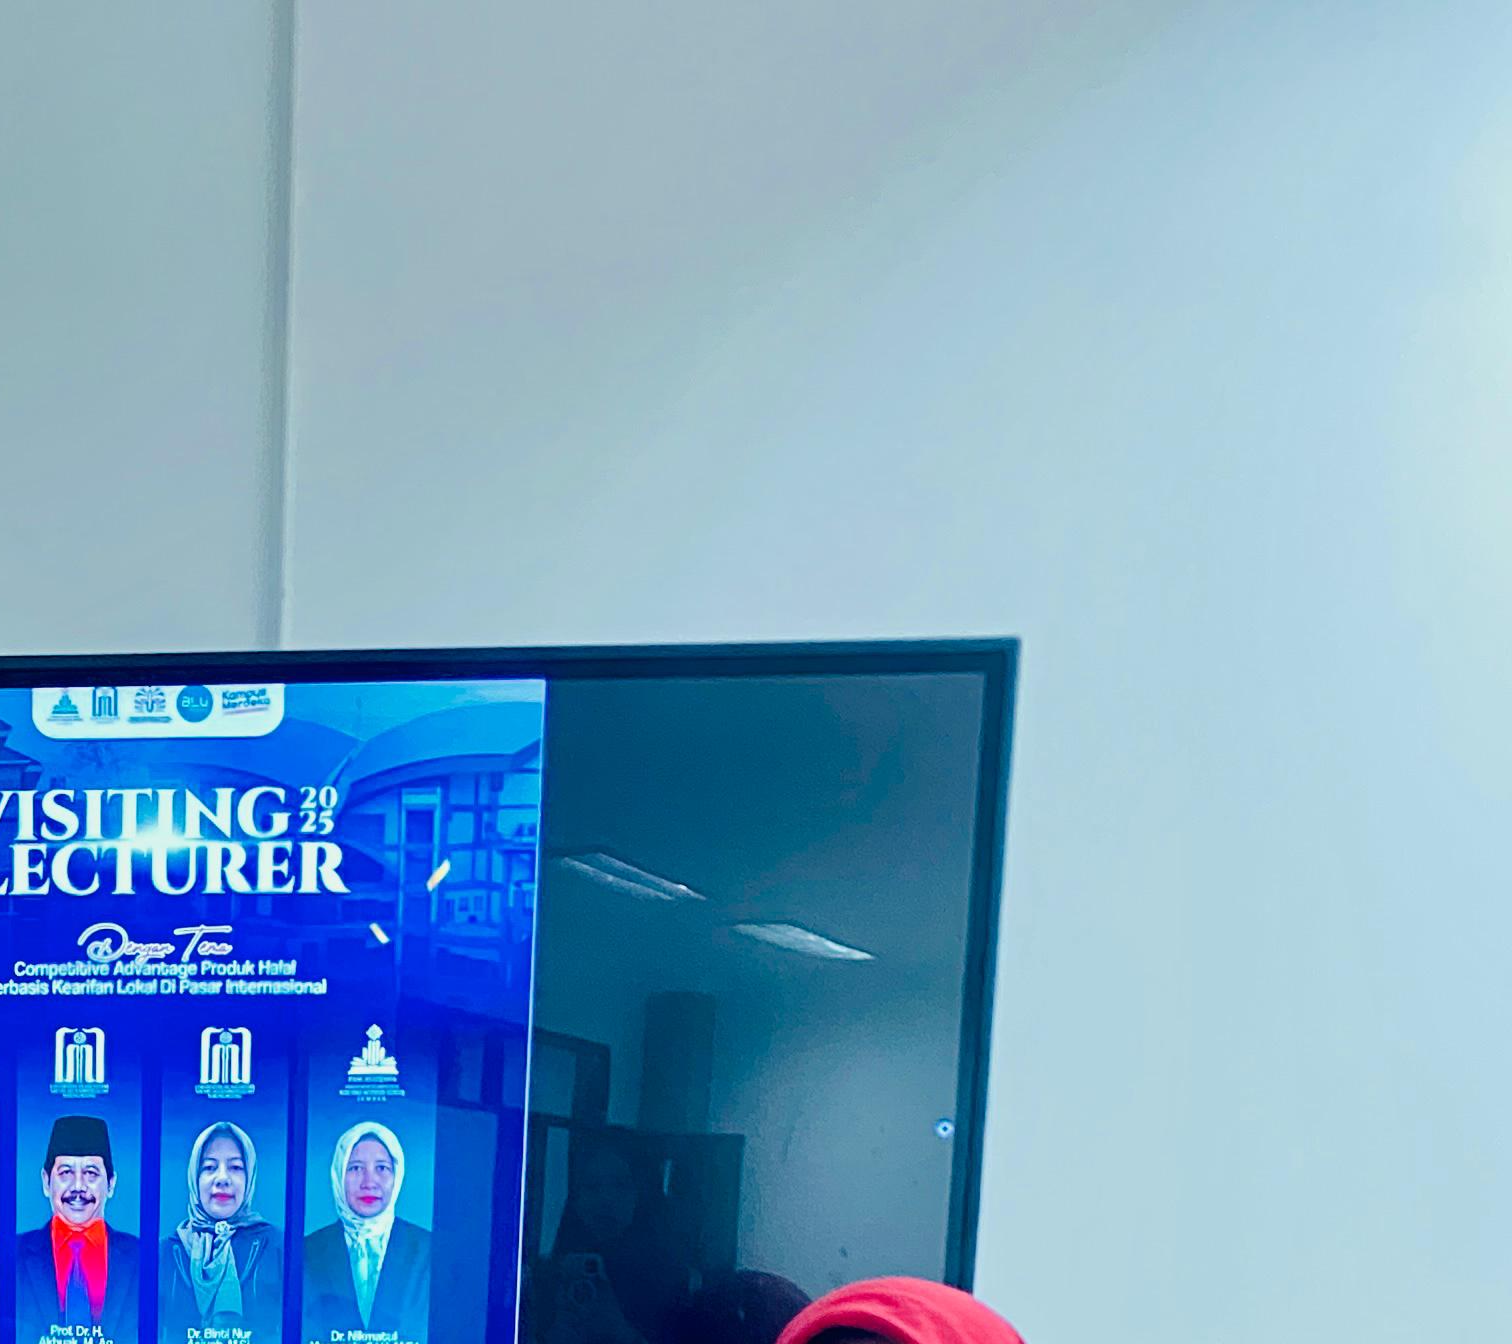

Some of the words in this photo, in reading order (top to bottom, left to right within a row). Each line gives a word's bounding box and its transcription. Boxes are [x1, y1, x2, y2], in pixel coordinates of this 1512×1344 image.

[299, 785, 338, 809] 20
[298, 809, 335, 834] 25
[14, 960, 110, 979] Competitive
[113, 960, 198, 979] Advantage
[201, 960, 255, 976] Produk
[258, 959, 297, 976] Halal
[52, 979, 114, 995] Kearifan
[116, 979, 157, 995] Lokal
[160, 979, 176, 994] Di
[179, 979, 223, 995] Pasar
[225, 978, 327, 995] Internasional
[50, 1324, 74, 1337] Prof.
[76, 1325, 90, 1337] Dr.
[187, 1327, 200, 1339] Dr.
[232, 1328, 252, 1339] Nur
[331, 1330, 345, 1342] Dr.
